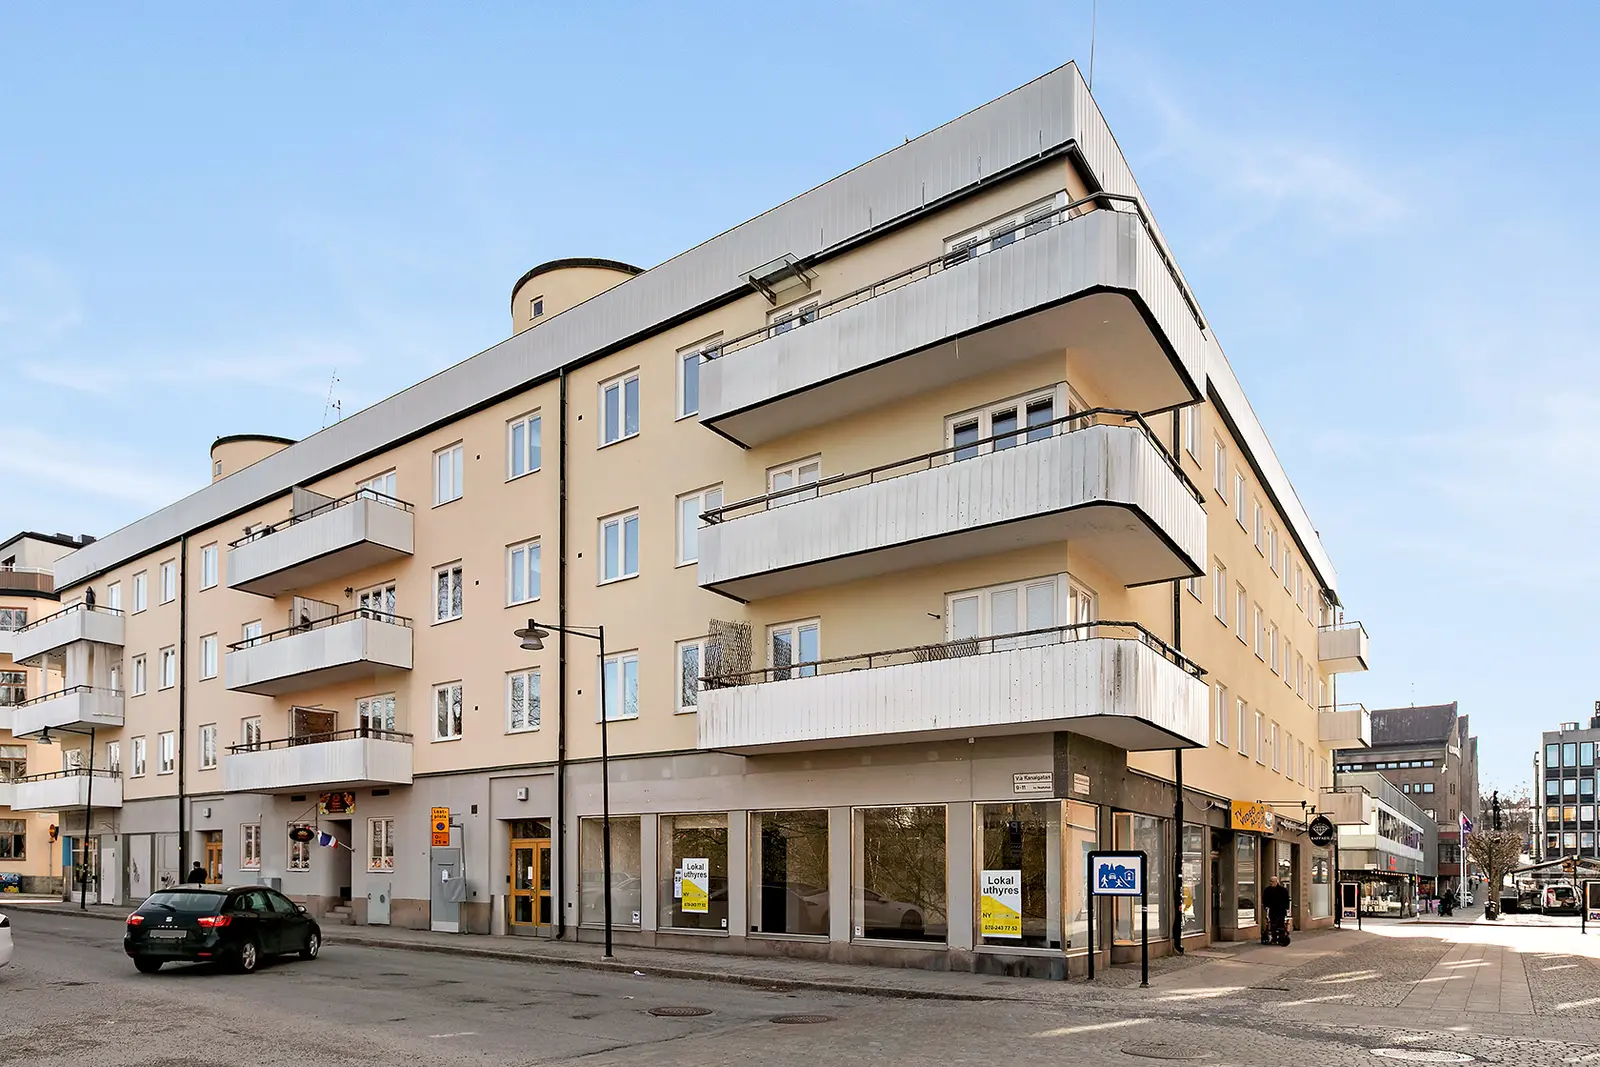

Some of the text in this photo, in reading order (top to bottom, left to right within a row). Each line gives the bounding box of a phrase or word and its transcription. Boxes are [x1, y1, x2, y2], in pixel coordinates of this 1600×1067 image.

[1240, 806, 1256, 826] VIDEO
[687, 863, 705, 871] Lokal
[683, 871, 708, 880] uthyres
[988, 876, 1014, 885] Lokal
[983, 886, 1019, 896] uthyres
